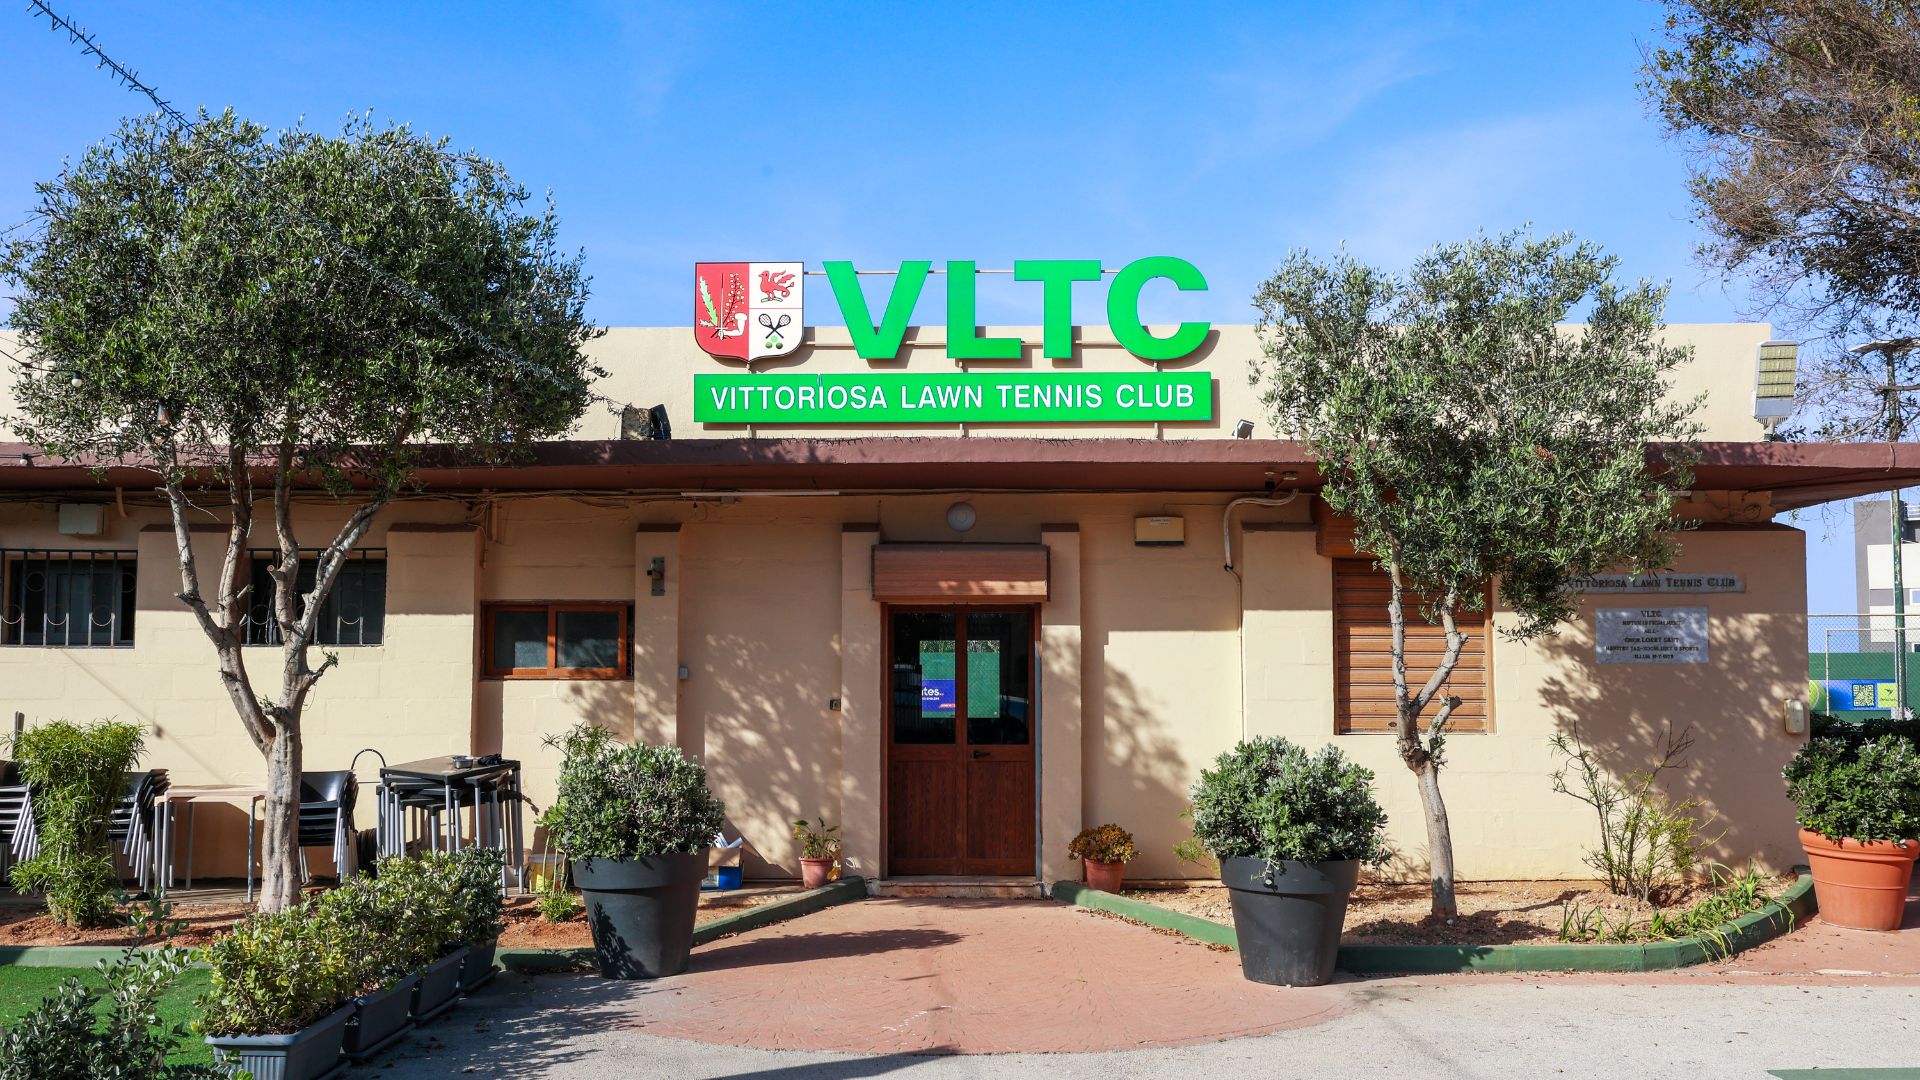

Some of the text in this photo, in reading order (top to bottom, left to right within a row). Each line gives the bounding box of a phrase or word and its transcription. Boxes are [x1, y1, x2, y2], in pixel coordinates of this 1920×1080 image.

[823, 256, 1211, 361] VLTC
[711, 383, 1195, 411] VITTORIOSA LAWN TENNIS CLUB
[1666, 577, 1702, 587] TENNIS
[1707, 577, 1736, 587] CLUB
